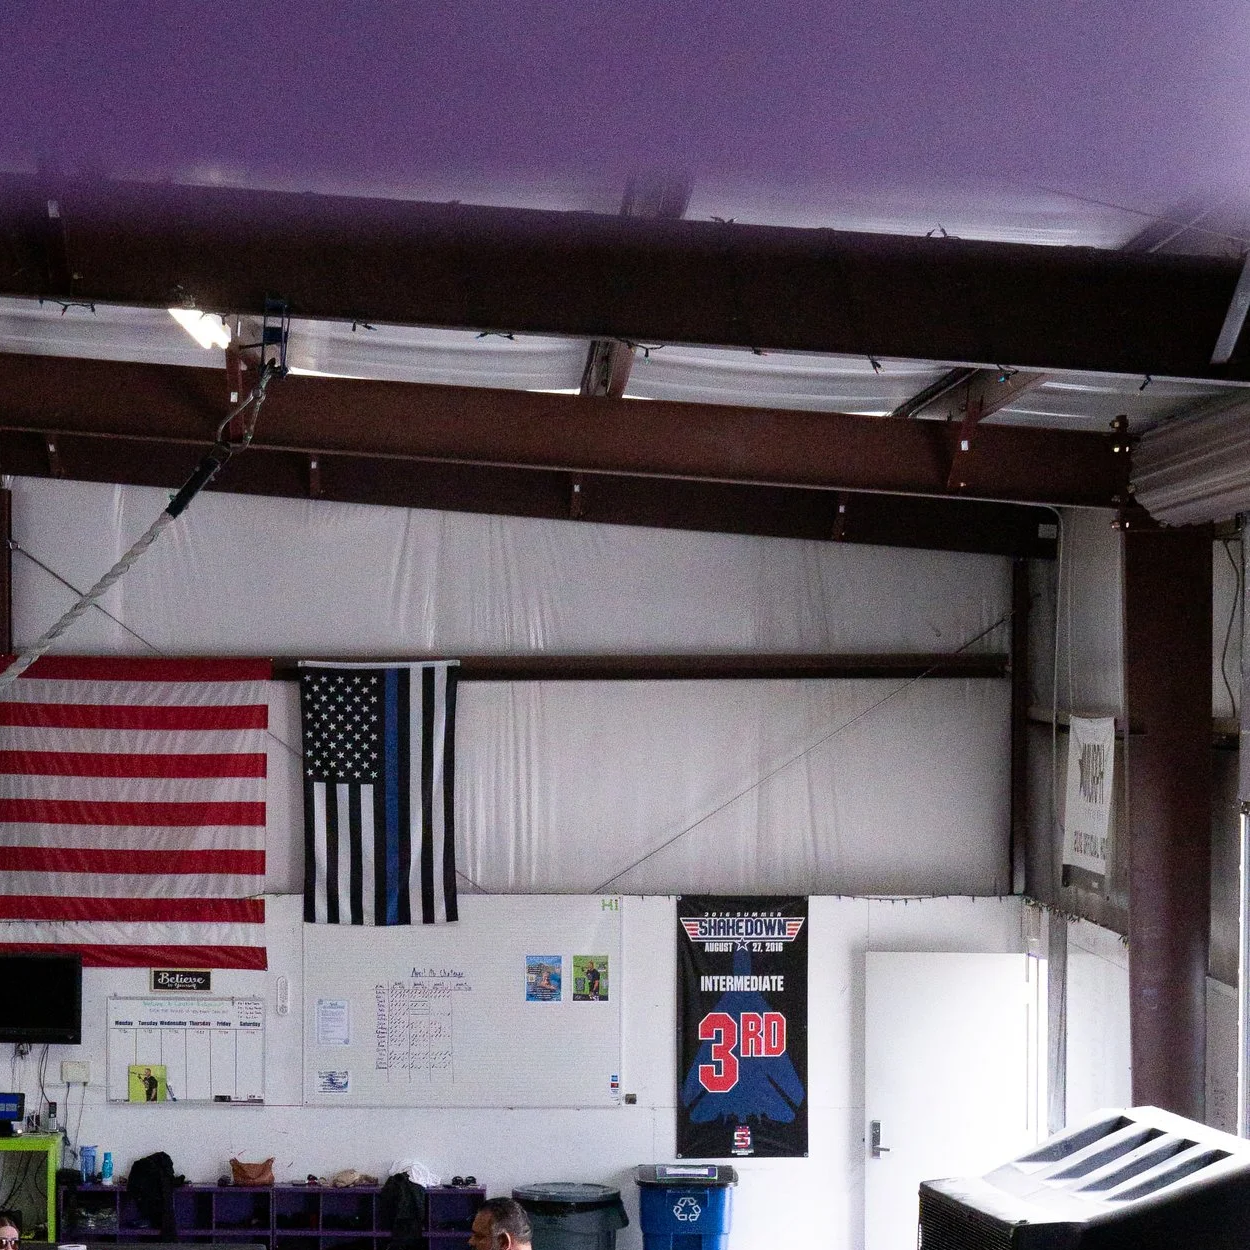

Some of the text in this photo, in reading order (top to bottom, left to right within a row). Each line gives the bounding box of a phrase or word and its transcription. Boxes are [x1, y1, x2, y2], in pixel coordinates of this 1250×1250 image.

[698, 918, 787, 937] SHAKEDOWN
[704, 942, 784, 953] AUGUST 27, 2016
[158, 972, 205, 985] Believe
[700, 975, 784, 992] INTERMEDIATE
[698, 1012, 787, 1093] 3RD
